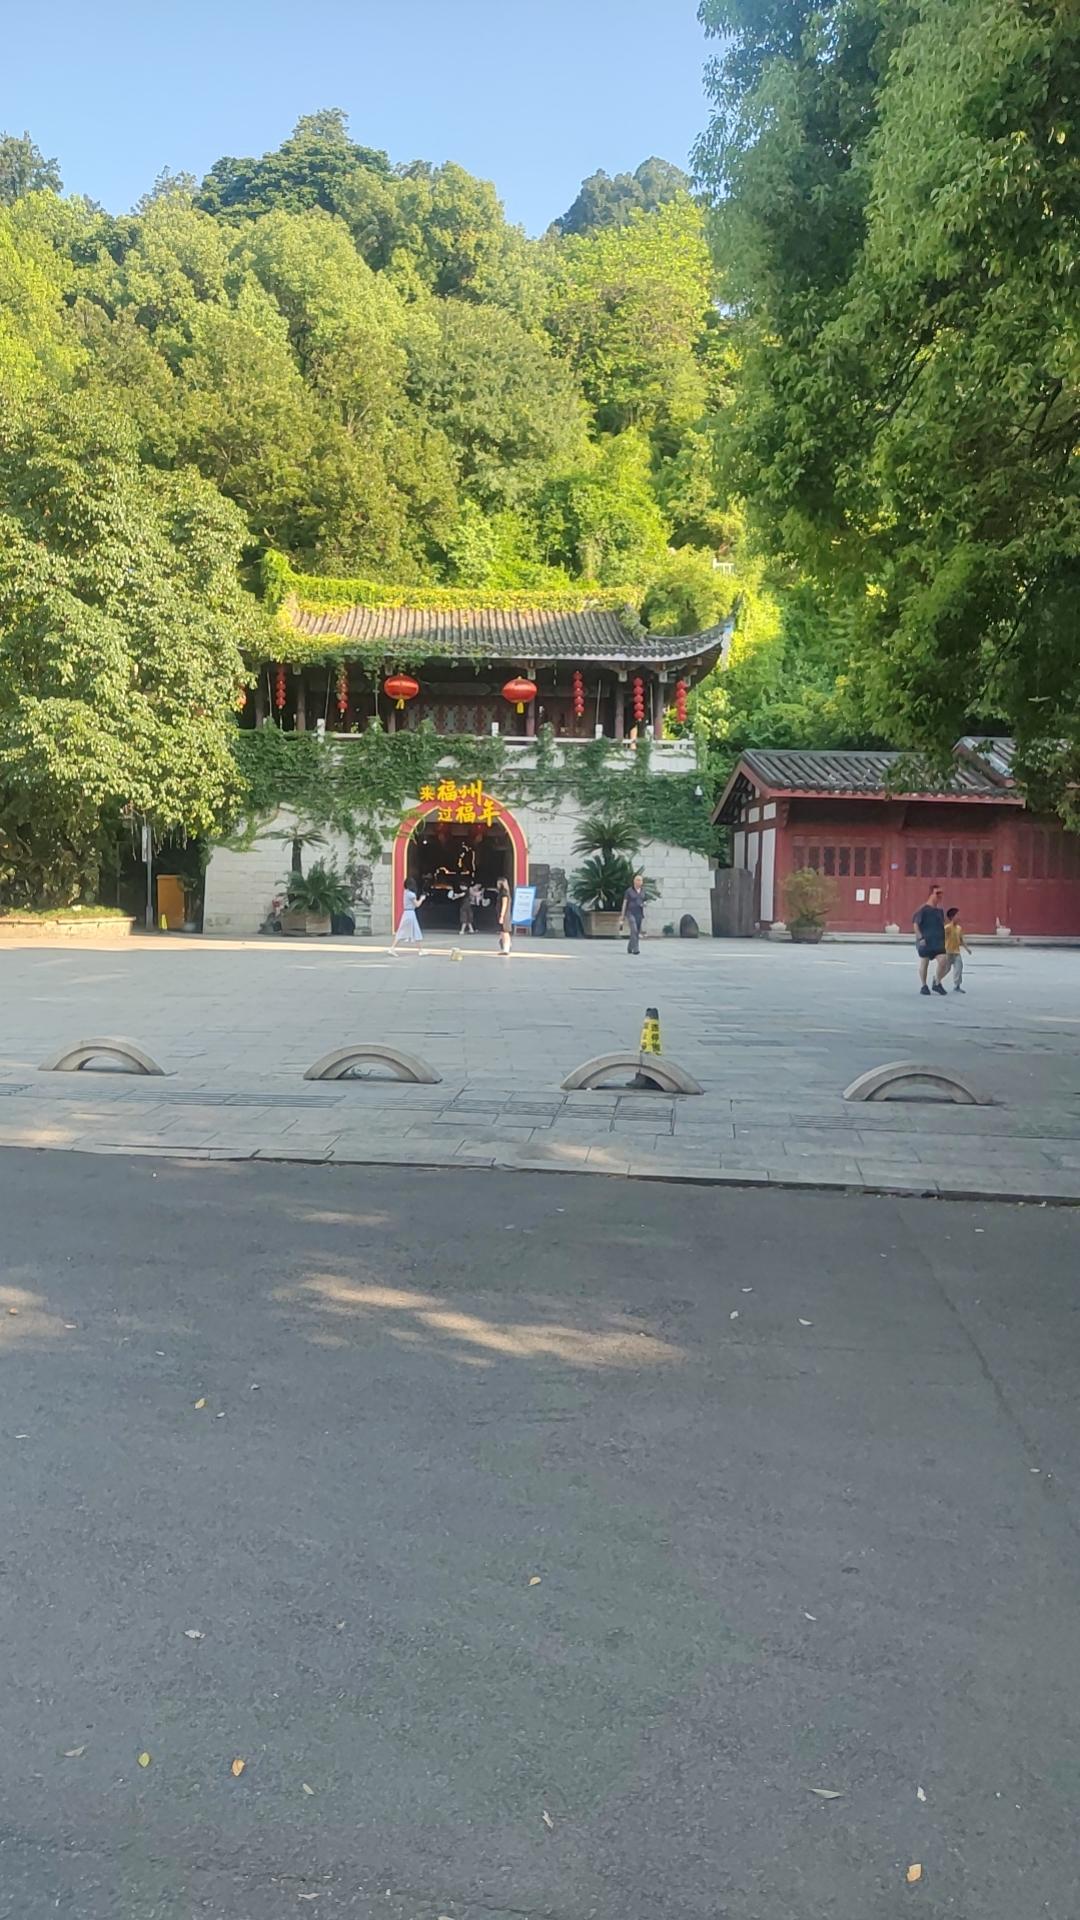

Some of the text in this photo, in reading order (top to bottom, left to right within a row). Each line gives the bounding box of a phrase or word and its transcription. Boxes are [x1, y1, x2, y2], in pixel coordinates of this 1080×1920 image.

[420, 779, 482, 806] 来福州
[438, 800, 501, 827] 过福年
